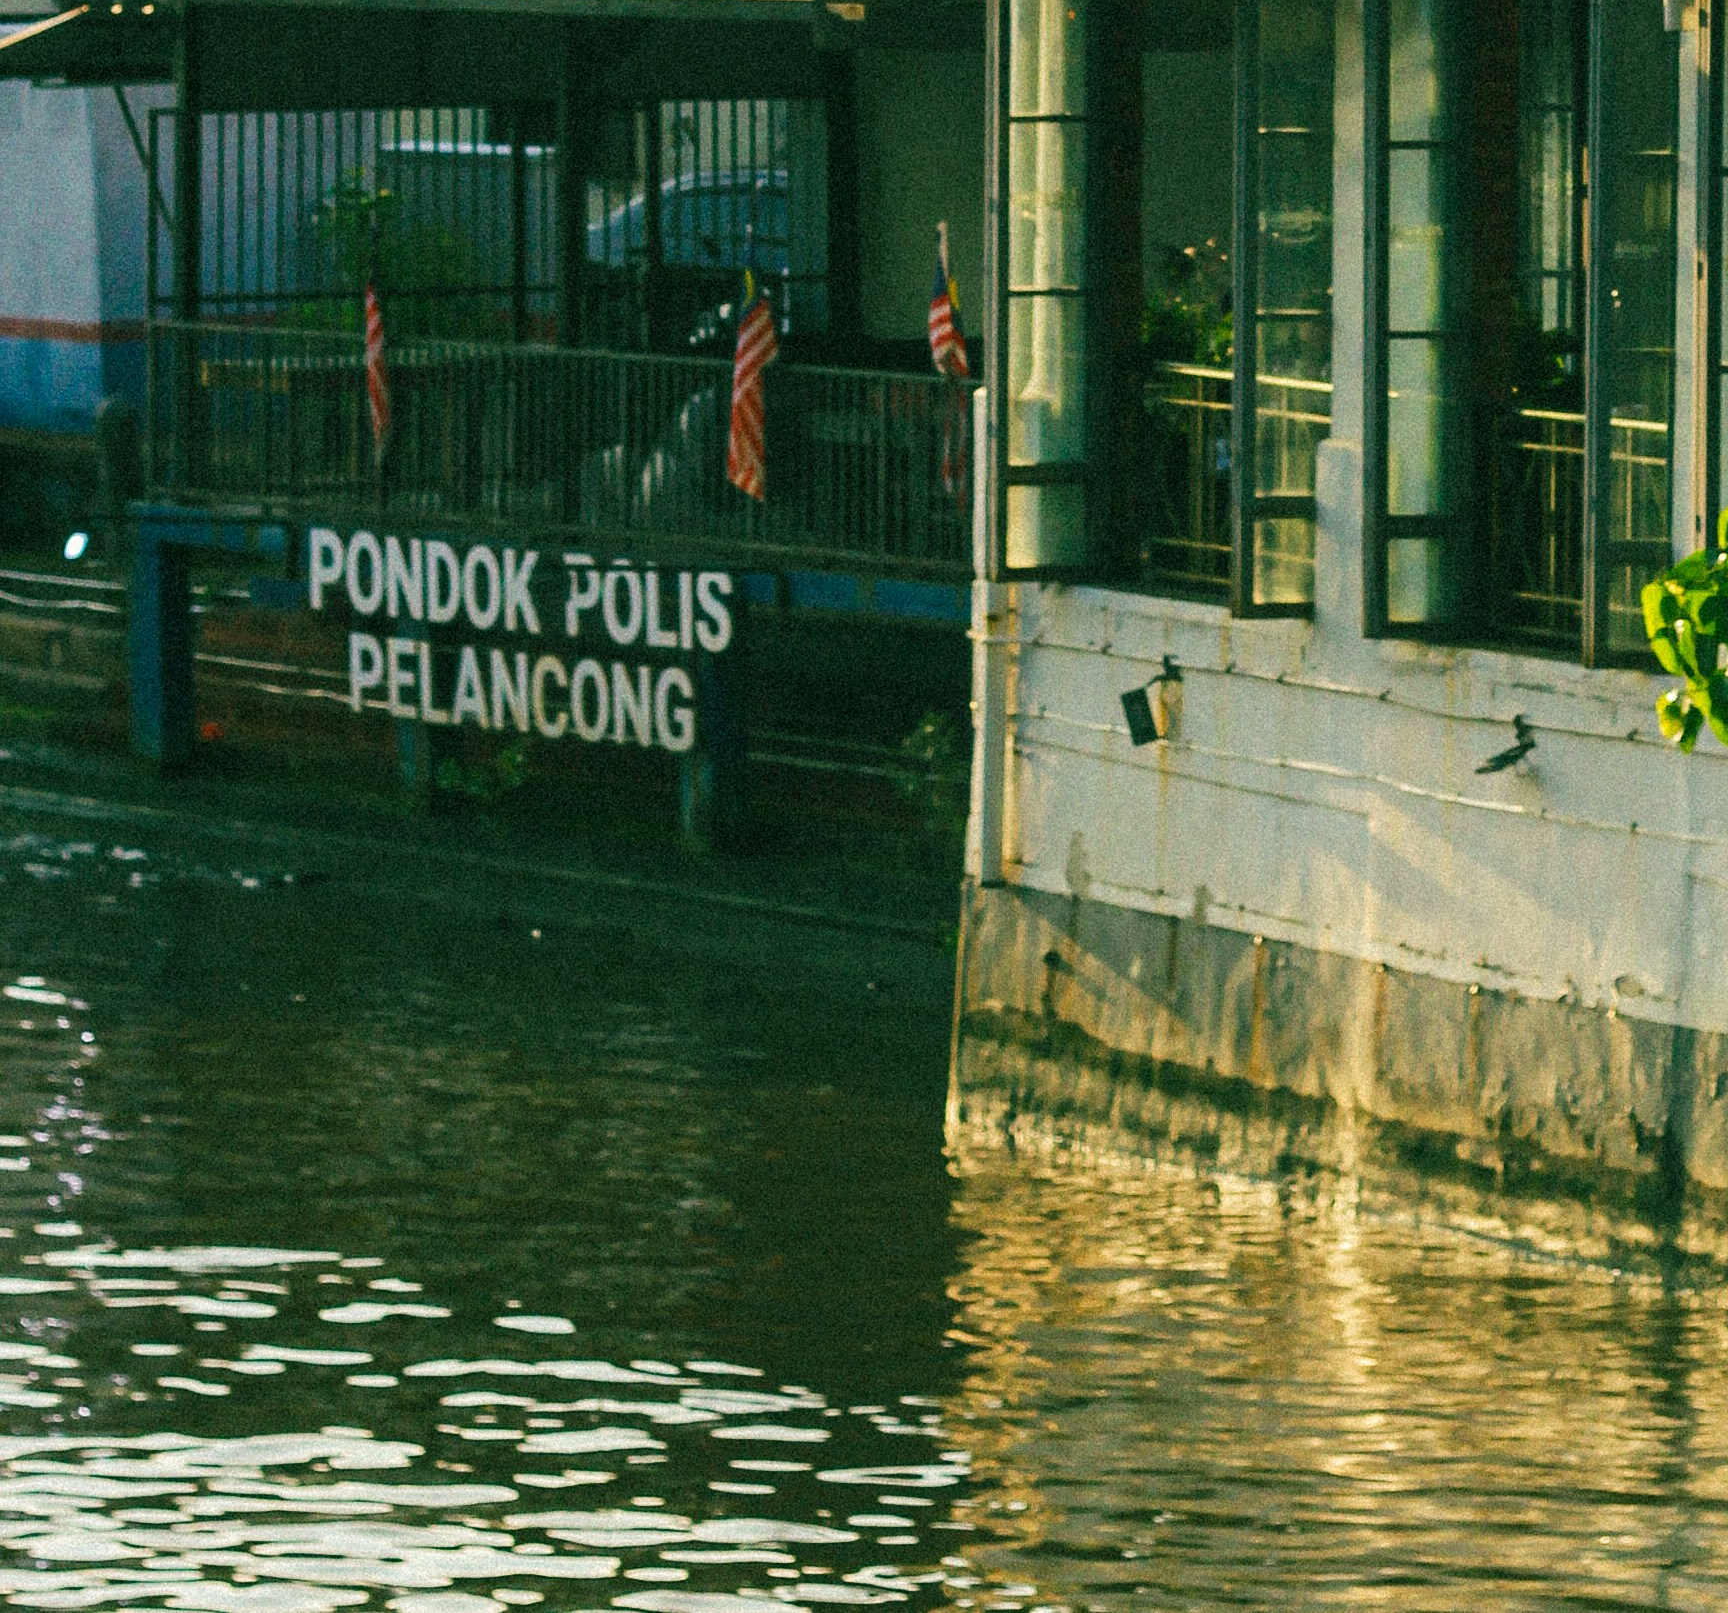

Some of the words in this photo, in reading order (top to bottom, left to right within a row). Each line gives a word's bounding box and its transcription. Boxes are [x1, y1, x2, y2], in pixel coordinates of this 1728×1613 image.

[308, 527, 541, 634] PONDOK
[563, 552, 733, 653] POLIS
[347, 632, 696, 752] PELANCONG
